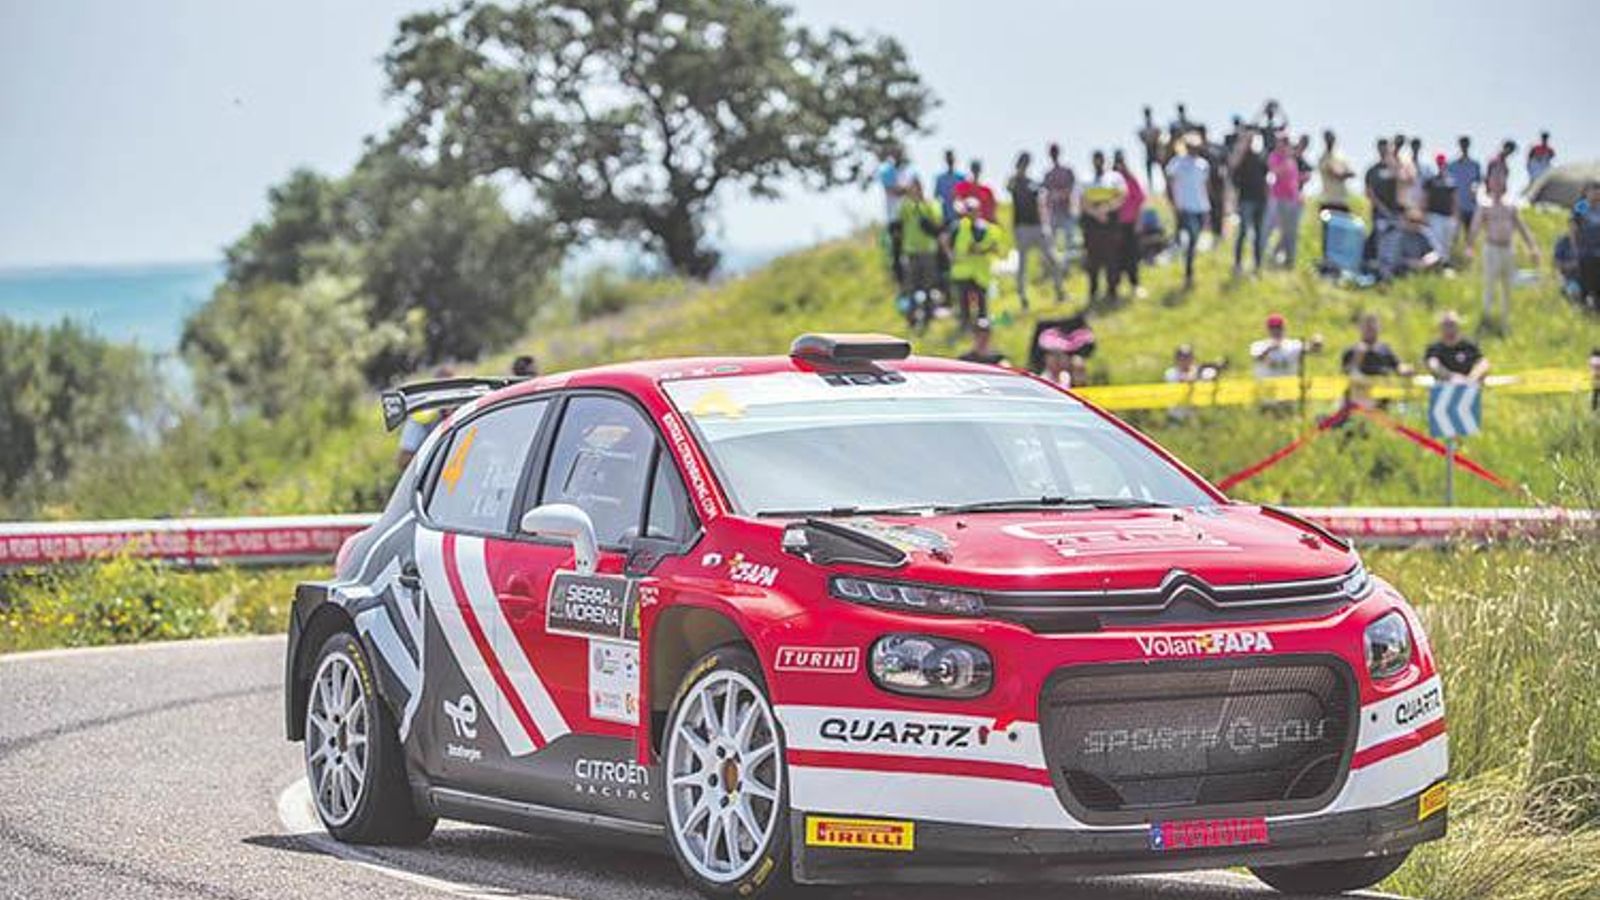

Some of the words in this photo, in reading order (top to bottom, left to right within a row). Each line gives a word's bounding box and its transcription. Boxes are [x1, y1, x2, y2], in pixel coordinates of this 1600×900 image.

[566, 584, 611, 604] SIERRA
[564, 602, 620, 627] MORENA
[1212, 631, 1274, 653] FAPA
[783, 650, 854, 668] TURINI
[820, 718, 971, 747] QUARTZ
[575, 784, 651, 801] RACING
[816, 822, 903, 846] PIRELLI
